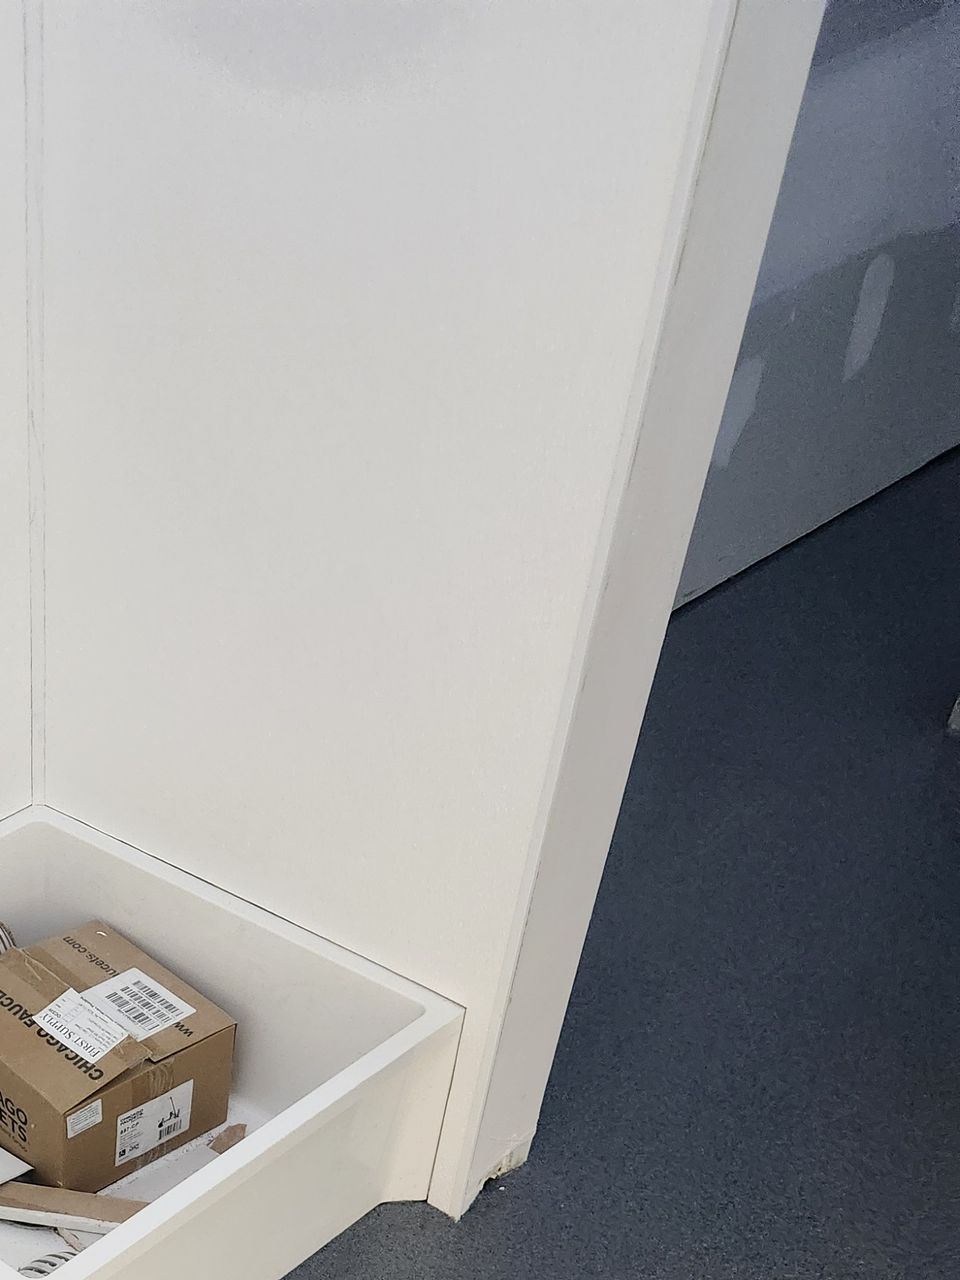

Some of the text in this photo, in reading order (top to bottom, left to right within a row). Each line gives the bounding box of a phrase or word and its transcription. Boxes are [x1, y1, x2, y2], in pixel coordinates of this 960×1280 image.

[42, 1013, 76, 1040] SUPPLY
[36, 1023, 104, 1080] CHICAGO
[73, 1036, 101, 1058] FIRST
